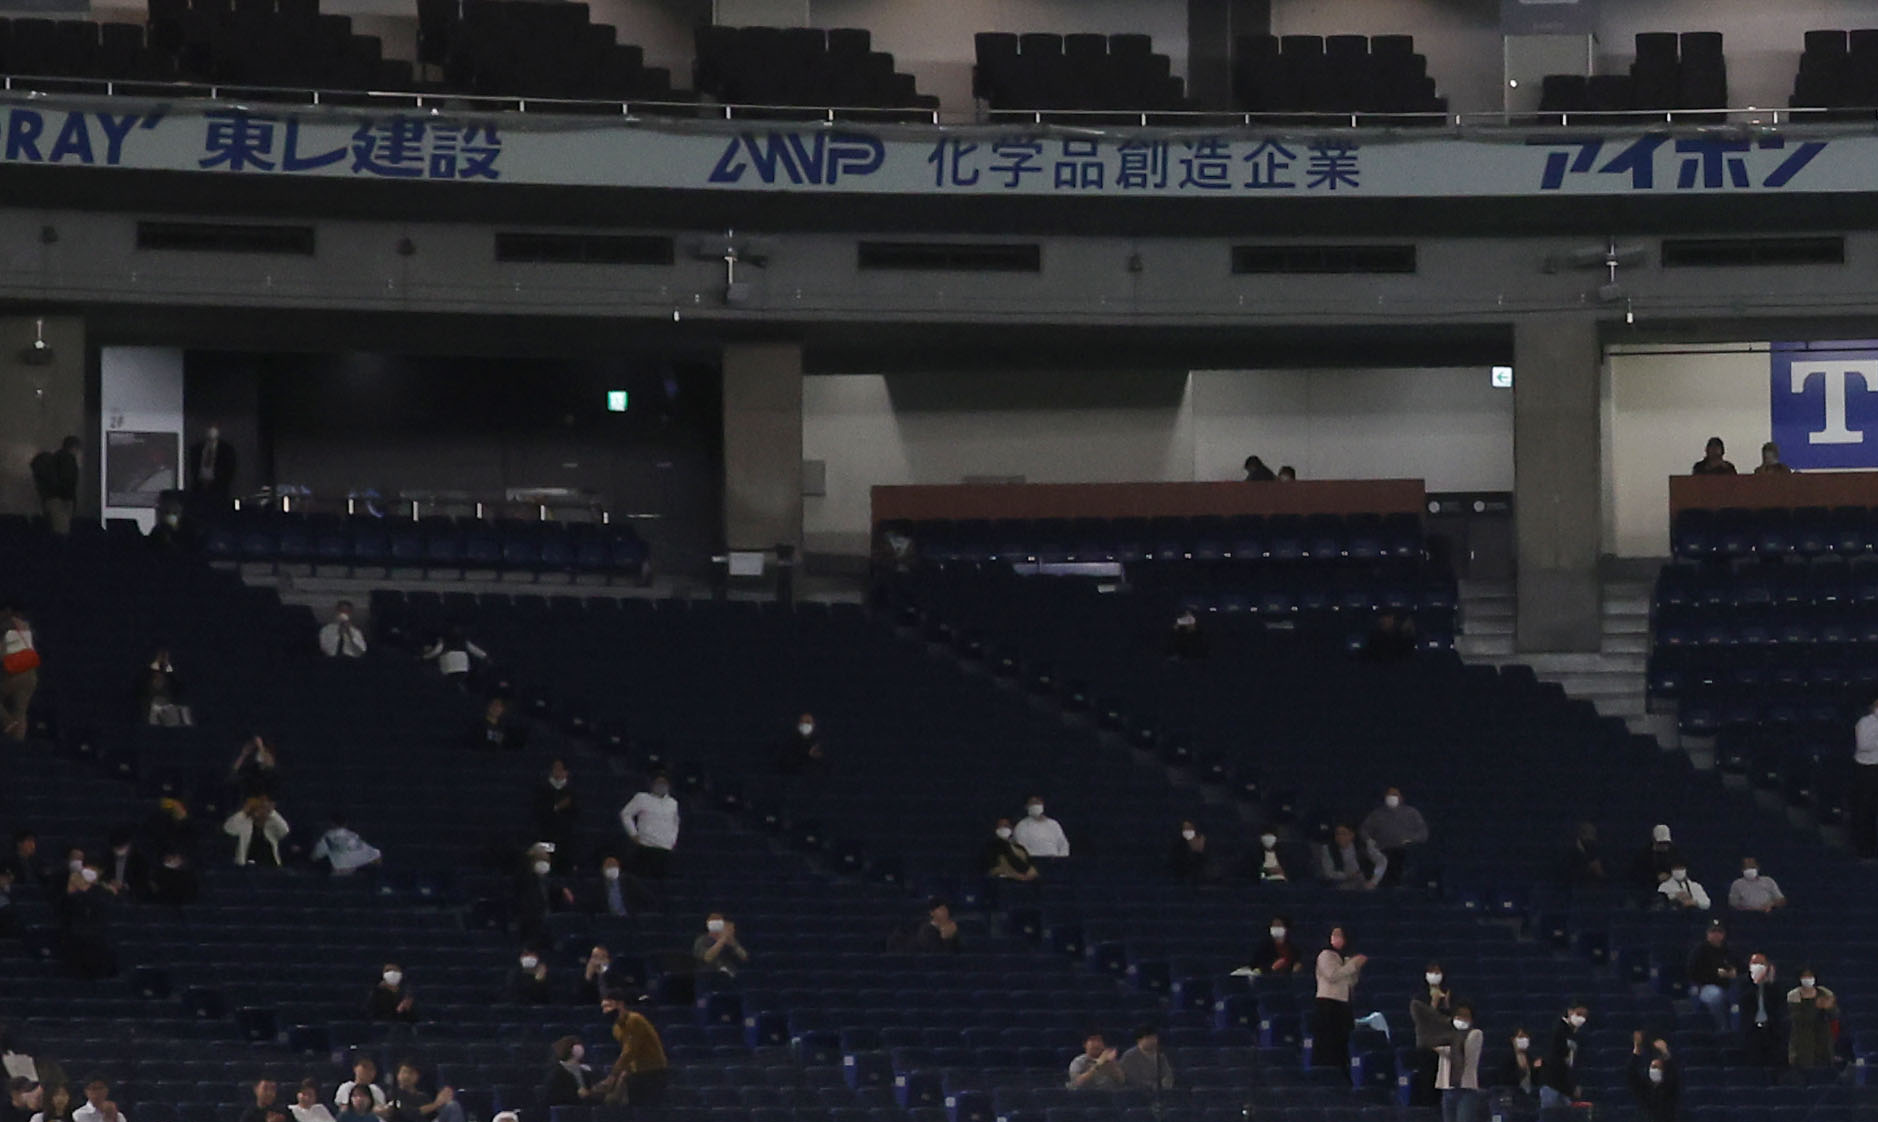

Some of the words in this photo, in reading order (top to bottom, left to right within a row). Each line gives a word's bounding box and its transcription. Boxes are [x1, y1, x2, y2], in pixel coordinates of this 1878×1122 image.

[199, 110, 503, 180] 東レ建設
[928, 135, 1361, 190] 化学品創造企業
